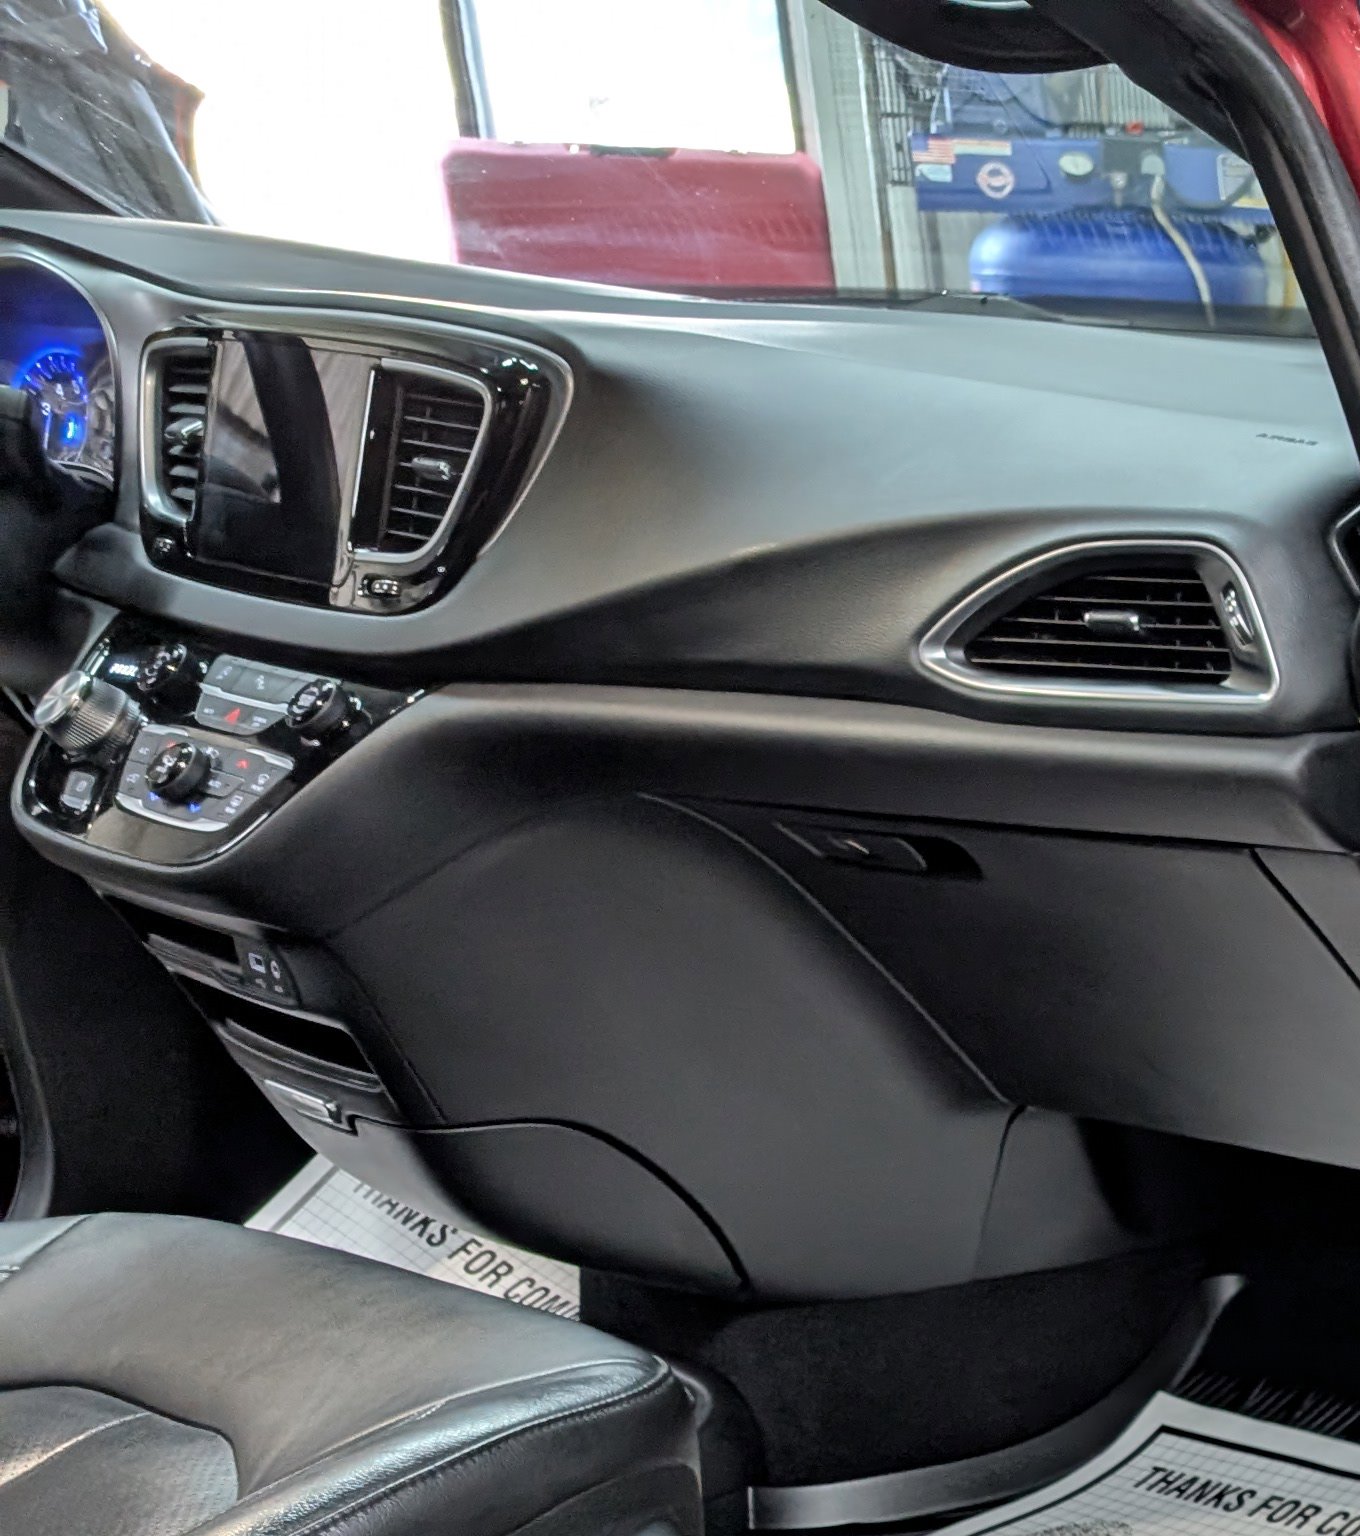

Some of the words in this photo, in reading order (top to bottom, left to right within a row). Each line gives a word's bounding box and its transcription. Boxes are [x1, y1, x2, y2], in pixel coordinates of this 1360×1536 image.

[447, 1237, 514, 1289] FOR
[1134, 1466, 1256, 1512] THANKS
[1249, 1494, 1322, 1530] FOR
